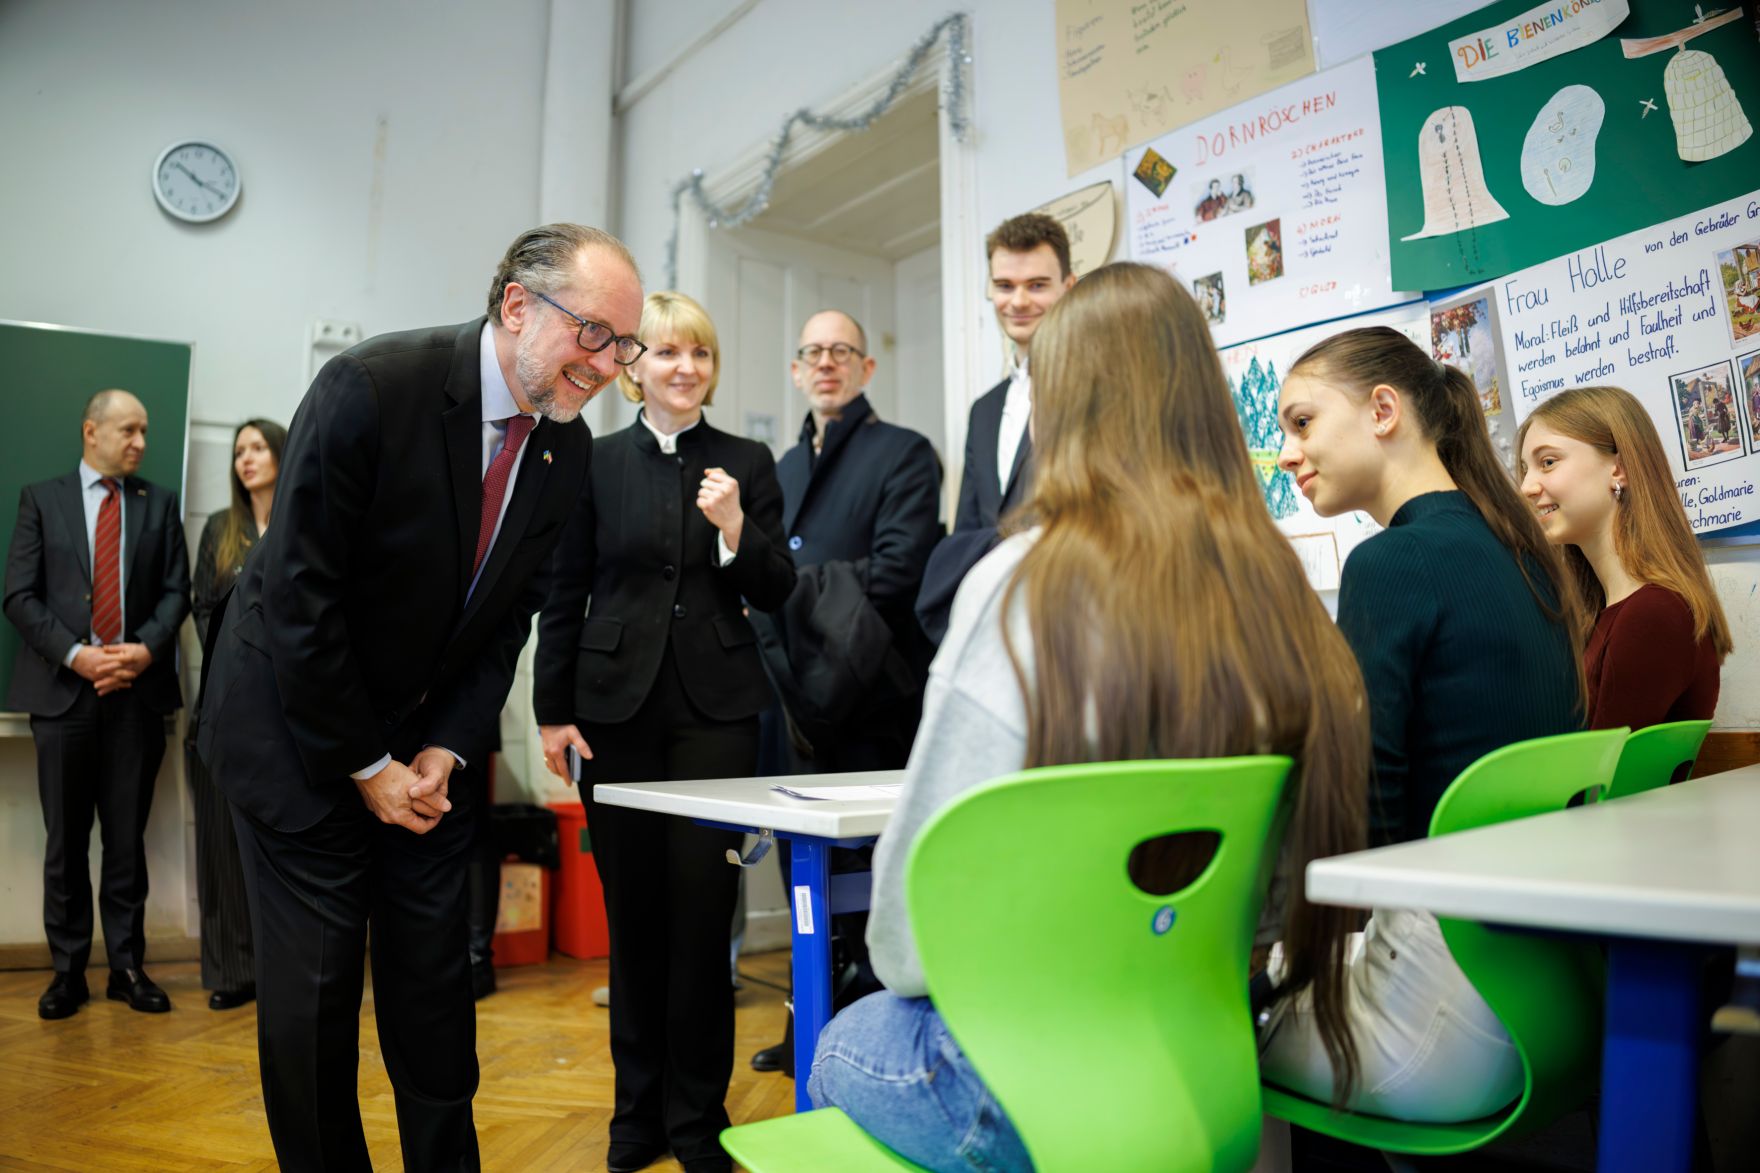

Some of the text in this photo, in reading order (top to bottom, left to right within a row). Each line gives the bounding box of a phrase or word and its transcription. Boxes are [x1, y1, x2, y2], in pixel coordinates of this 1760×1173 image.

[1457, 38, 1499, 69] DIE
[1195, 91, 1336, 166] DORNRÖSCHEN
[1644, 240, 1663, 254] von
[1669, 231, 1688, 247] den
[1694, 212, 1740, 236] Gebrüder
[1505, 245, 1626, 316] Frau Holle
[1588, 301, 1610, 327] und
[1620, 268, 1710, 316] Hilfsbereitschaft
[1518, 295, 1716, 373] werden belohnt und Faulheit und
[1521, 334, 1679, 402] Egoismus werden bestraft.
[1699, 480, 1754, 505] Goldmarie
